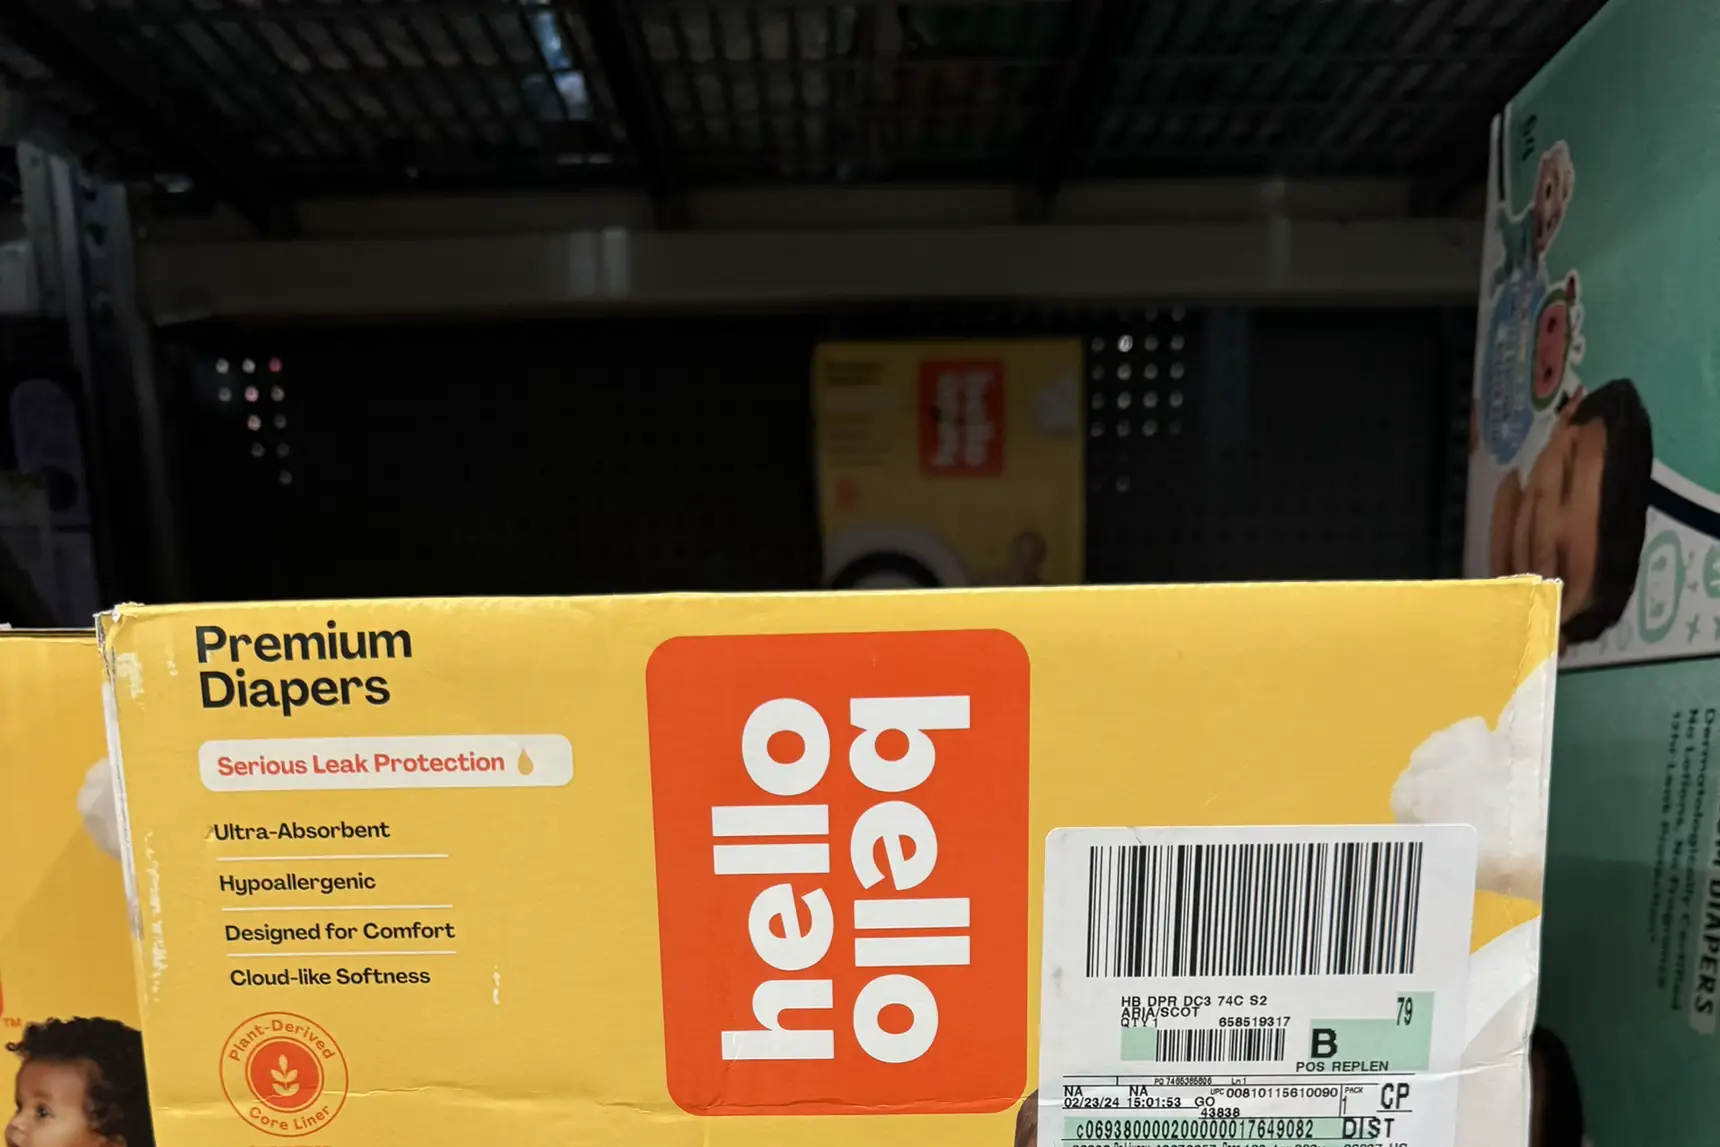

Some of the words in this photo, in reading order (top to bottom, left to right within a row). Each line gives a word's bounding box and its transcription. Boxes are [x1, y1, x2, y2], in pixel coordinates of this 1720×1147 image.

[195, 620, 412, 664] Premium
[199, 668, 391, 717] Diapers
[217, 754, 307, 777] Serious
[313, 753, 369, 775] Leak
[374, 751, 505, 773] Protection
[214, 821, 390, 842] Ultra-Absorbent
[219, 872, 376, 894] Hypoallergenic
[711, 698, 835, 1061] hello
[848, 695, 970, 1064] bello
[225, 922, 321, 944] Designed
[326, 922, 358, 940] for
[362, 921, 455, 940] Comfort
[230, 968, 332, 987] Cloud-like
[336, 967, 431, 985] Softness
[1121, 996, 1141, 1007] HB
[1148, 996, 1177, 1007] DPR
[1184, 996, 1211, 1006] DC3
[1218, 996, 1243, 1006] 74C
[1249, 995, 1267, 1006] S2
[1397, 997, 1413, 1026] 79
[1121, 1018, 1149, 1028] QTY
[1219, 1017, 1291, 1027] 658519317
[228, 1019, 336, 1062] Plant-Derived
[1311, 1028, 1338, 1058] B
[1296, 1062, 1325, 1072] POS
[1332, 1061, 1389, 1072] REPLEN
[1064, 1086, 1083, 1096] NA
[1129, 1086, 1149, 1096] NA
[1226, 1087, 1338, 1098] 00810115610090
[1381, 1083, 1410, 1110] CP
[1064, 1097, 1119, 1108] 02/23/24
[1127, 1097, 1182, 1108] 15:01:53
[1200, 1107, 1241, 1118] 43838
[249, 1106, 289, 1130] Core
[293, 1105, 330, 1130] Liner
[1342, 1117, 1395, 1138] DIST
